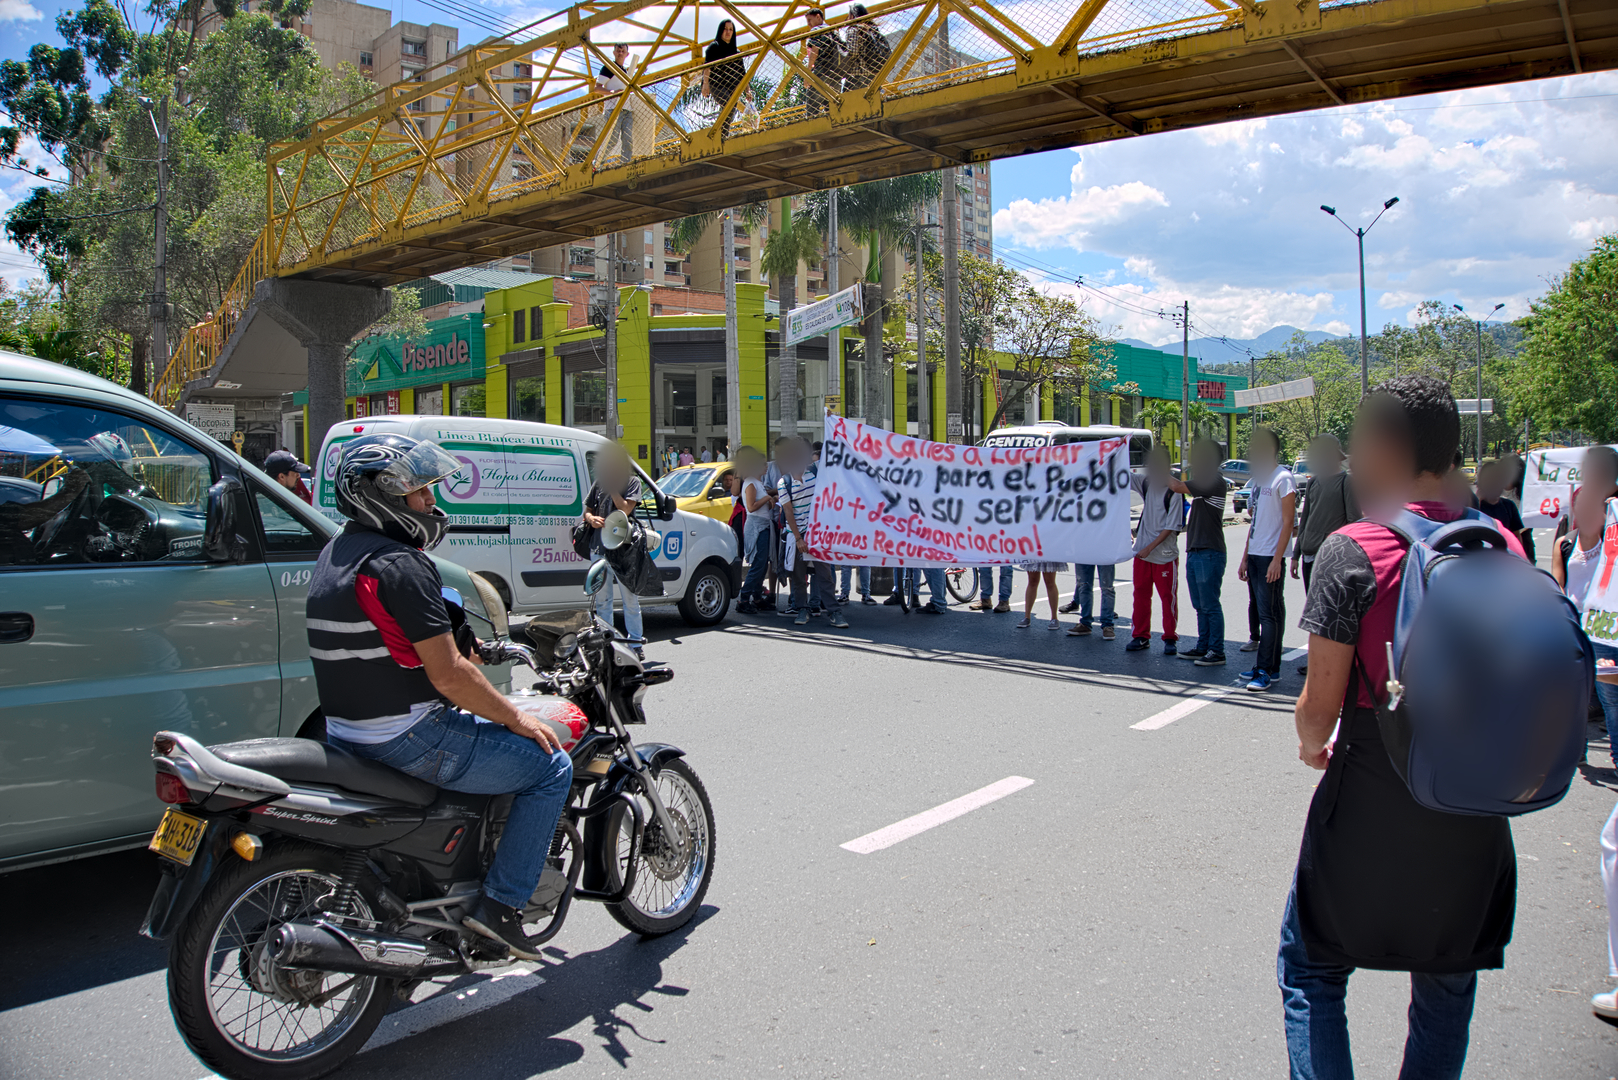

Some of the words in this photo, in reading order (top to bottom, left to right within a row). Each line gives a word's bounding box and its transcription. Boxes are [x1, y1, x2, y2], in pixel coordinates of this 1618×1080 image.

[187, 412, 230, 428] Fotocopias
[437, 430, 475, 441] Linea
[478, 433, 526, 444] Blanca:
[985, 436, 1046, 447] CENTRO
[963, 447, 983, 466] a
[935, 465, 994, 494] para
[1003, 462, 1036, 492] el
[1045, 453, 1130, 495] Pueblo
[1538, 452, 1560, 482] La
[481, 467, 519, 490] Hojas
[522, 468, 572, 483] Blancas
[974, 492, 1107, 525] servicio
[1540, 498, 1560, 519] es
[448, 515, 457, 524] 01
[449, 535, 556, 548] www.hojasblancas.com
[280, 569, 312, 587] 049
[263, 807, 300, 819] Super
[300, 813, 338, 825] Sprint
